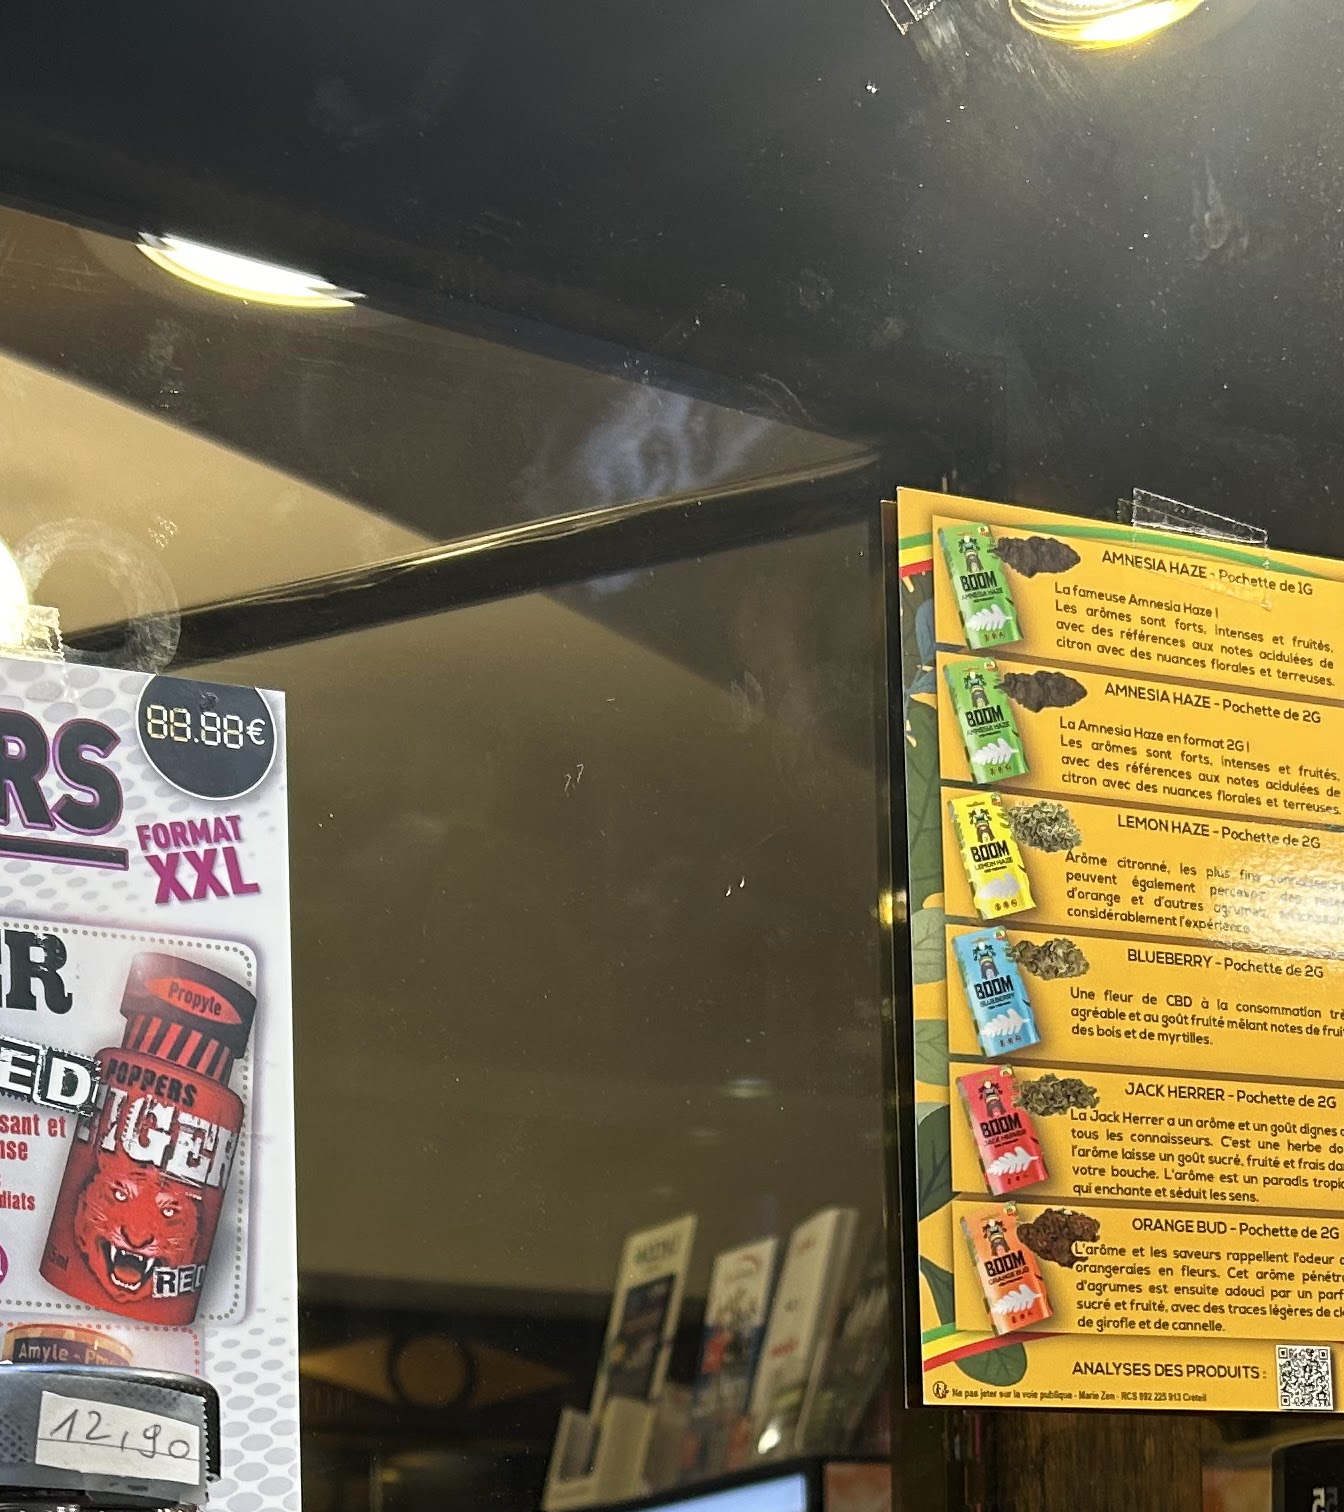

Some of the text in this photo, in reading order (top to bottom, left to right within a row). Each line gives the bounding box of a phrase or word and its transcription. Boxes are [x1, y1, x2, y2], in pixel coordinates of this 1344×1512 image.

[1101, 550, 1313, 596] AMNESIA HAZE Pochette de 1G
[1104, 682, 1321, 724] AMNESIA HAZE Pochette de 2G
[137, 816, 242, 852] FORMAT
[1117, 814, 1321, 849] LEMON HAZE Pochette de 2G
[146, 852, 260, 904] XXL
[1127, 948, 1324, 979] BLUEBERRY Pochette de 2G
[168, 982, 221, 1016] Propyle
[1070, 986, 1096, 1001] Une
[1103, 989, 1134, 1003] fleur
[1141, 992, 1158, 1006] de
[1165, 994, 1193, 1008] CBD
[1200, 997, 1210, 1010] à
[1216, 998, 1229, 1011] la
[1235, 1003, 1322, 1018] consommation
[1124, 1082, 1337, 1109] JACK HERRER Pochette de 2G
[48, 1115, 66, 1138] et
[1131, 1217, 1340, 1240] ORANGE BUD Pochette de 2G
[1071, 1361, 1260, 1379] ANALYSES DES PRODUITS
